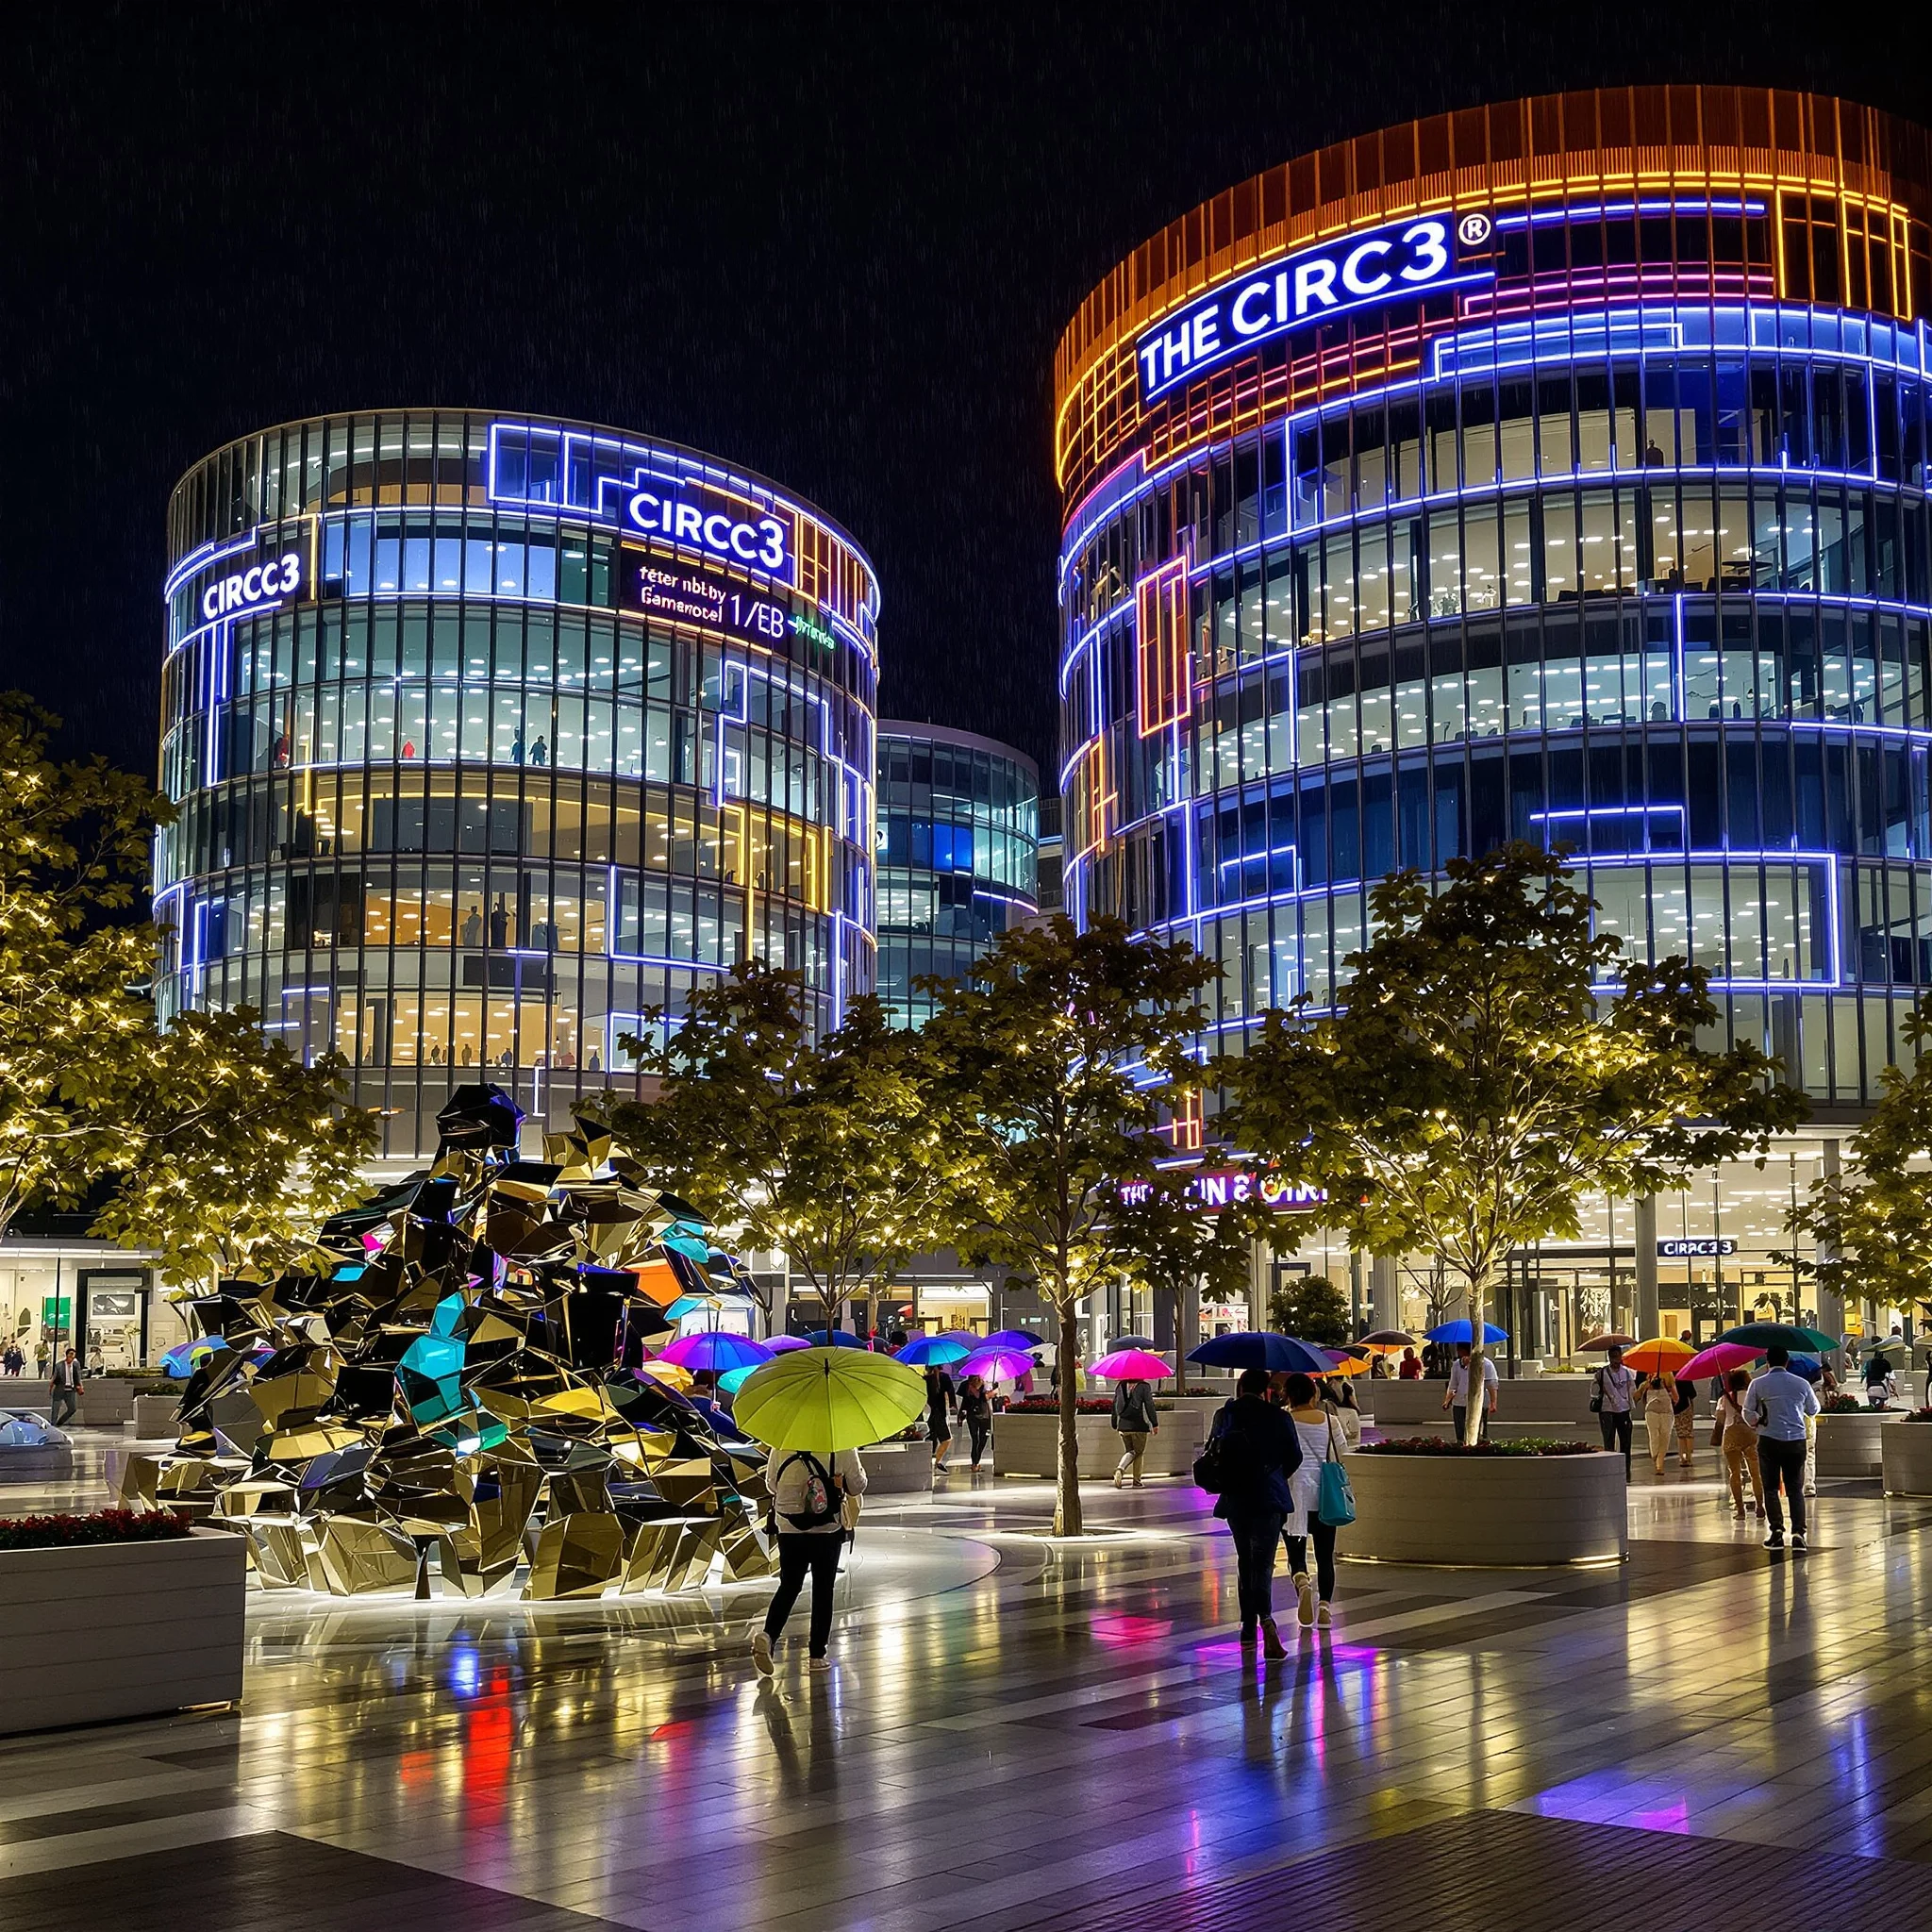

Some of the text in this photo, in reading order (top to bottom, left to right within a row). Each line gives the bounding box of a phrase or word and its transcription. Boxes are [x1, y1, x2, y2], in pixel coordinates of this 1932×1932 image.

[1141, 304, 1221, 390] THE
[629, 492, 784, 568] CIRCC3
[203, 553, 300, 620] CIRCC3
